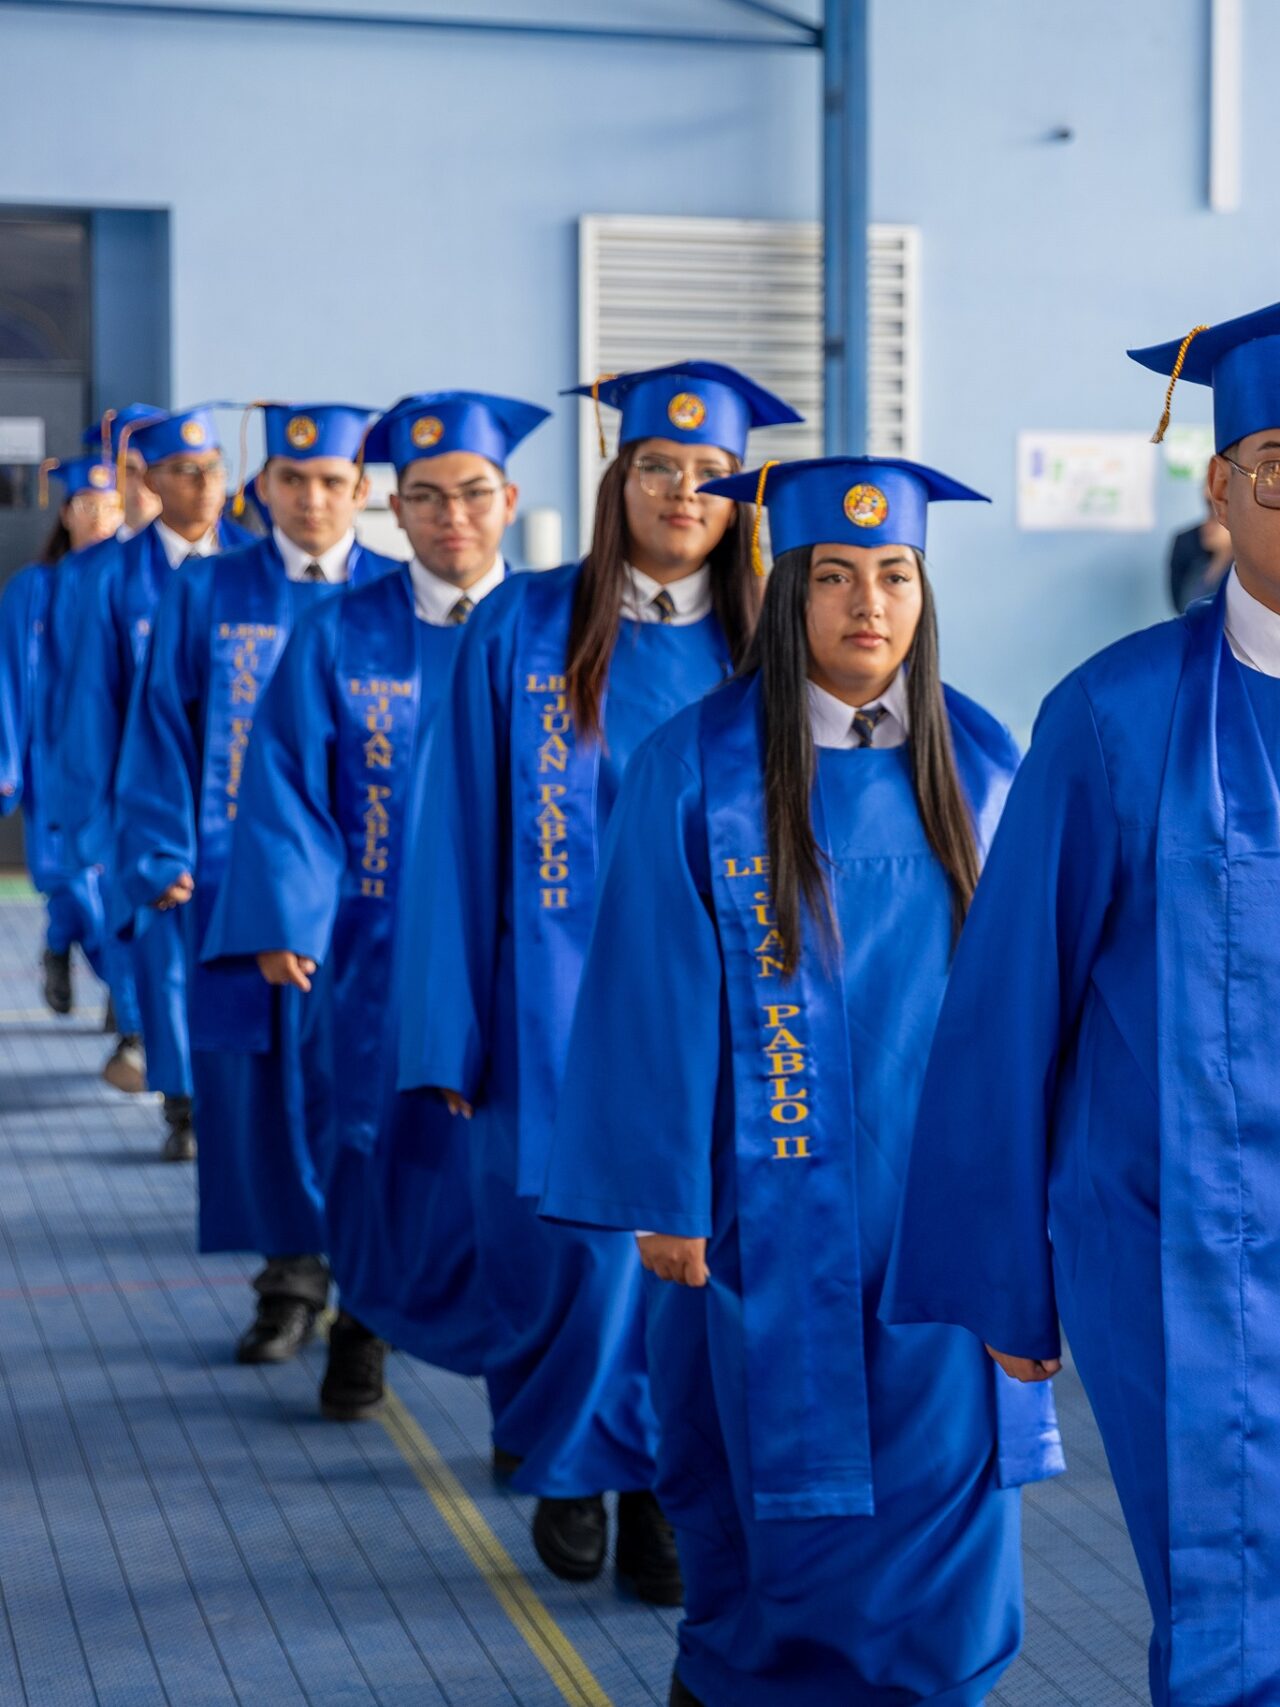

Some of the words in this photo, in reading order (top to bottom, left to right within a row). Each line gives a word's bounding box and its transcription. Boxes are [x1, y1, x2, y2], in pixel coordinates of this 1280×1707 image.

[231, 639, 259, 704] JUAN
[364, 696, 393, 769] JUAN
[537, 694, 572, 773] JUAN
[363, 784, 392, 873] PABLO
[536, 784, 569, 882] PABLO
[361, 878, 385, 897] II
[539, 888, 569, 909] II
[762, 1004, 809, 1125] PABLO
[771, 1136, 812, 1160] II
